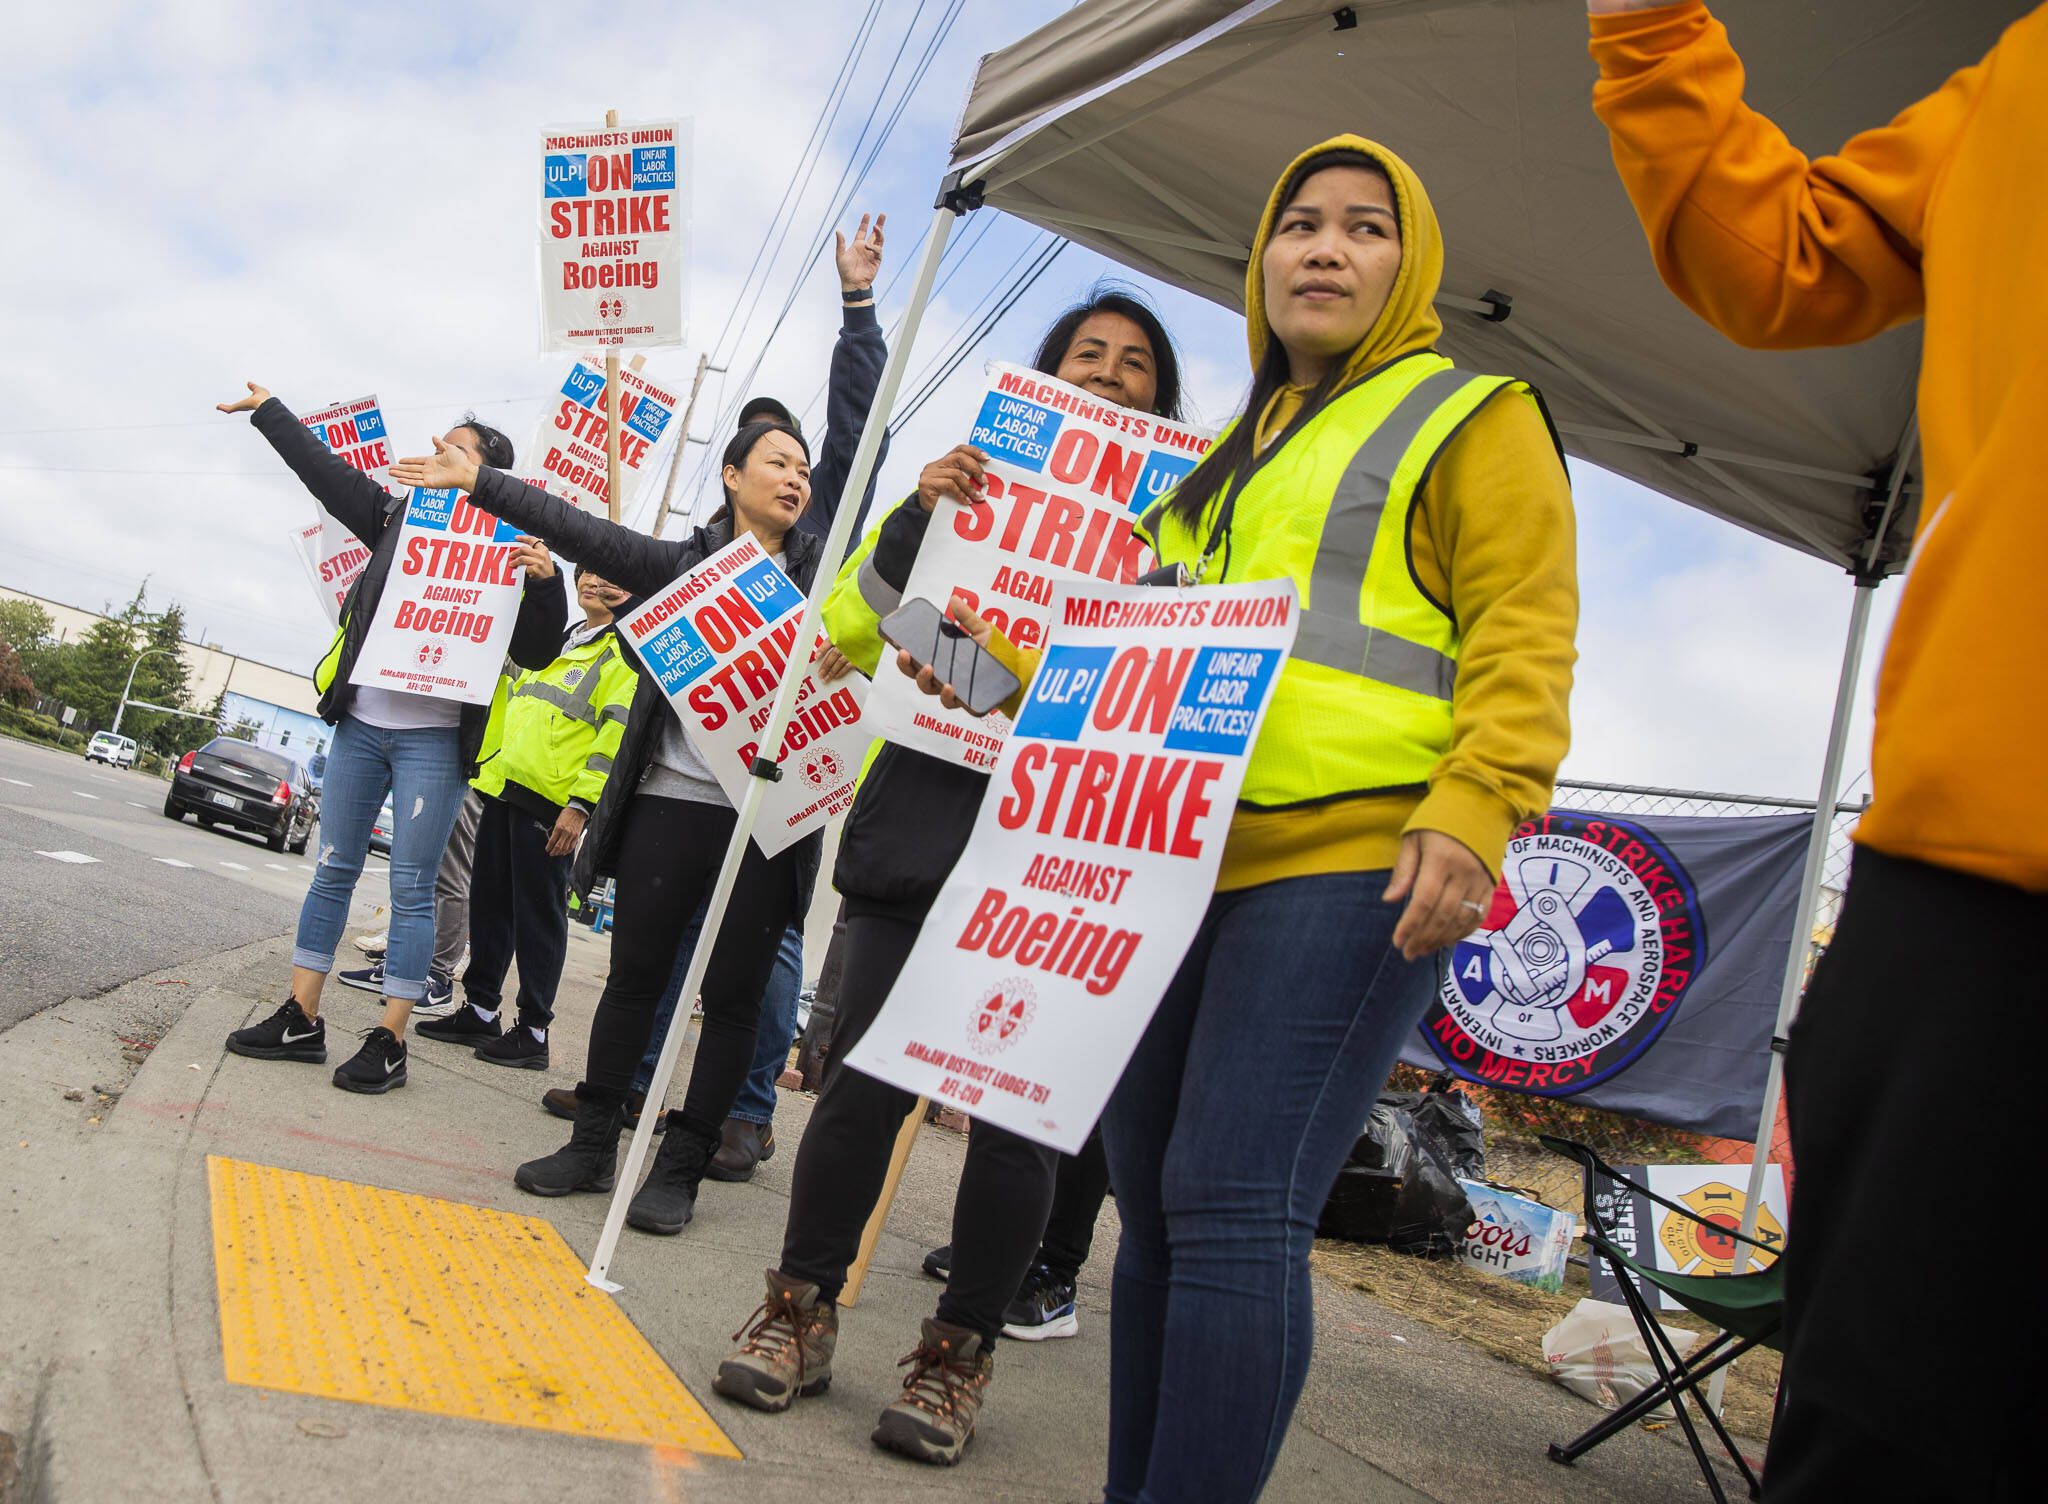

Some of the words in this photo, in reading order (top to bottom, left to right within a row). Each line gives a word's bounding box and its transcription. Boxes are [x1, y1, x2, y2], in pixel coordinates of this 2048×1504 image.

[546, 132, 628, 150] MACHINISTS
[632, 128, 672, 144] UNION
[640, 150, 667, 160] UNFAIR
[548, 163, 582, 182] ULP!
[587, 153, 632, 192] ON
[633, 172, 674, 184] PRACTICES!
[642, 161, 666, 171] LABOR
[550, 194, 670, 238] STRIKE
[582, 240, 639, 258] AGAINST
[564, 258, 658, 290] Boeing
[595, 328, 624, 336] DISTRICT
[624, 326, 643, 334] LODGE
[644, 326, 654, 334] 751
[571, 371, 599, 396] ULP!
[644, 384, 676, 408] UNION
[350, 399, 376, 414] UNION
[642, 410, 661, 427] LABOR
[644, 401, 666, 419] UNFAIR
[997, 372, 1150, 439] MACHINISTS
[1154, 424, 1213, 456] UNIO
[998, 398, 1046, 426] UNFAIR
[327, 420, 359, 448] ON
[358, 416, 381, 432] ULP!
[554, 400, 650, 470] STRKE
[631, 413, 662, 438] PRACTICES!
[993, 414, 1038, 441] LABOR
[338, 442, 390, 472] RIKE
[567, 442, 608, 472] AGAINS
[971, 426, 1048, 462] PRACTICES!
[1048, 428, 1145, 506] ON
[410, 507, 450, 524] PRACTICES!
[420, 497, 446, 510] LABOR
[450, 496, 498, 538] ON
[953, 470, 1159, 586] STRIK
[402, 536, 521, 586] STRIKE
[422, 584, 482, 605] AGAINST
[629, 566, 722, 640] MACHINISTS
[717, 542, 760, 576] UNION
[749, 572, 787, 603] ULP!
[991, 566, 1053, 607] AGAI
[394, 600, 494, 644] Boeing
[694, 586, 765, 655] ON
[1063, 596, 1207, 629] MACHINISTS
[1211, 595, 1292, 628] UNION
[650, 626, 684, 655] UNFAIR
[662, 640, 692, 666] LABOR
[380, 668, 406, 680] IAM&AW
[406, 672, 436, 683] DISTRICT
[436, 676, 456, 686] LODGE
[456, 680, 468, 689] 751
[660, 644, 710, 687] PRACTICES!
[1207, 652, 1261, 678] UNFAIR
[406, 682, 432, 693] AFL-CIO
[1036, 667, 1098, 705] ULP!
[1092, 646, 1196, 736] ON
[1198, 679, 1247, 704] LABOR
[913, 712, 964, 739] IAM&AW
[964, 728, 1004, 754] DISTRI
[1172, 704, 1256, 737] PRACTICES!
[964, 748, 998, 770] AFL-C
[786, 802, 818, 828] IAM&AW
[818, 782, 854, 808] DISTRICT
[998, 743, 1226, 860] STRIKE
[1512, 838, 1531, 854] OF
[1536, 838, 1633, 886] MACHINISTS
[1022, 854, 1132, 906] AGAINST
[1582, 822, 1684, 914] STRIKE
[1651, 916, 1691, 1014] HARD
[1629, 889, 1656, 923] AND
[956, 888, 1144, 998] Boeing
[1462, 955, 1482, 982] A
[1584, 978, 1612, 1004] M
[1616, 928, 1660, 1026] AEROSPACE
[1442, 971, 1502, 1050] INTERNATI
[1432, 1012, 1476, 1060] NO
[1478, 1050, 1599, 1088] MERCY
[1534, 1024, 1618, 1060] WORKERS
[904, 1040, 948, 1068] IAM&AW
[945, 1054, 995, 1084] DISTRICT
[992, 1070, 1030, 1098] LODGE
[1028, 1084, 1052, 1104] 751
[938, 1076, 985, 1106] AFL-CIO
[1464, 1220, 1531, 1256] oors
[1758, 1226, 1781, 1244] A
